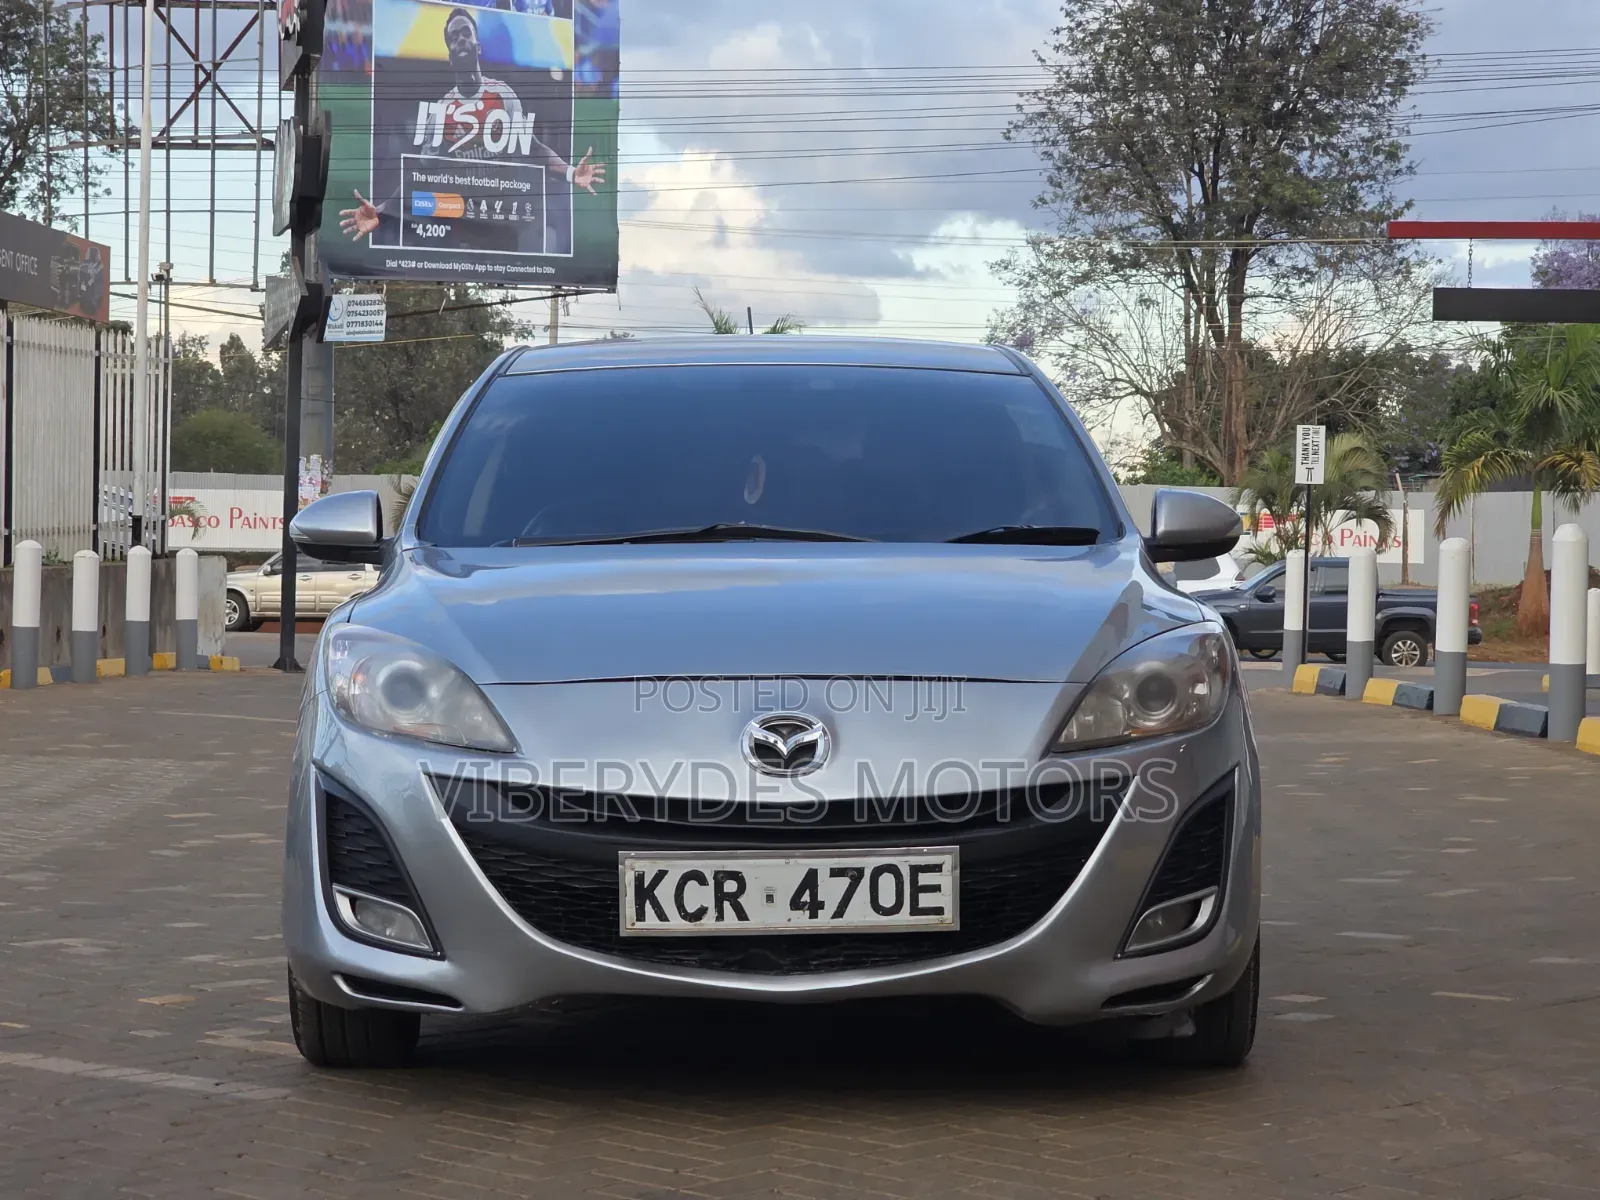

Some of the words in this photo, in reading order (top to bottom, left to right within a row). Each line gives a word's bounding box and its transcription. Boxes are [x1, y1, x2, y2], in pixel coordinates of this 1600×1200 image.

[413, 100, 484, 153] IT'S
[482, 108, 536, 156] ON
[412, 172, 426, 182] The
[427, 174, 454, 184] world's
[454, 178, 471, 186] best
[471, 178, 499, 188] football
[500, 181, 531, 192] package
[0, 248, 14, 270] ENT
[15, 252, 38, 276] OFFICE
[386, 259, 398, 268] Dial
[424, 261, 453, 270] Download
[453, 262, 475, 272] MyDStv
[475, 264, 487, 273] App
[494, 264, 506, 274] stay
[506, 265, 537, 273] Connected
[1302, 427, 1311, 441] YOU
[1312, 426, 1321, 440] TIME
[1301, 442, 1311, 466] THANK
[1311, 440, 1320, 456] NEXT
[634, 869, 750, 923] KCR
[788, 863, 945, 921] 470E
